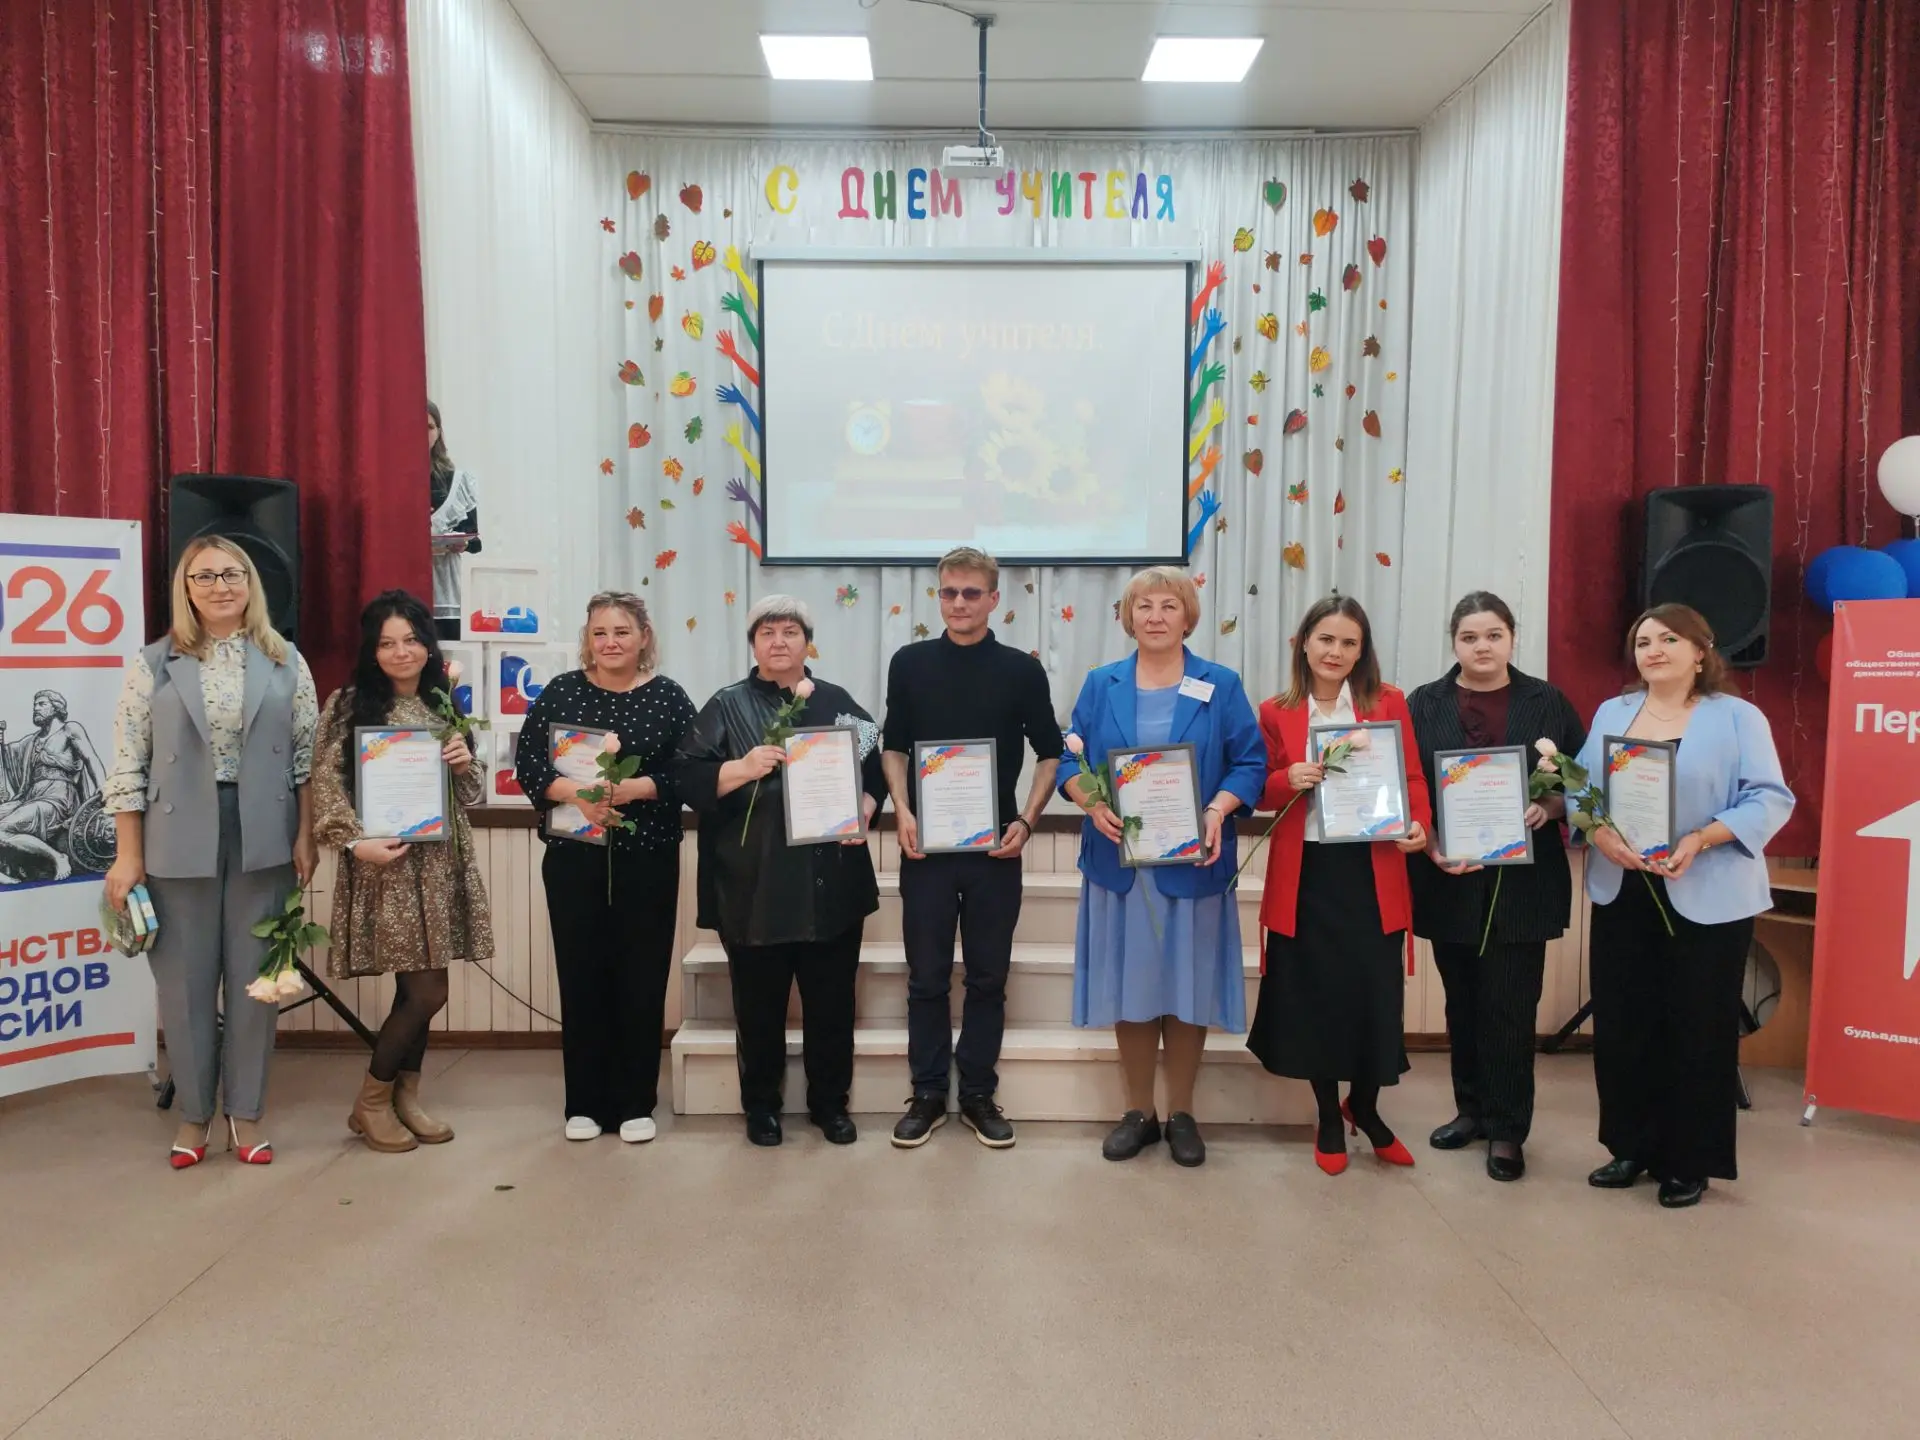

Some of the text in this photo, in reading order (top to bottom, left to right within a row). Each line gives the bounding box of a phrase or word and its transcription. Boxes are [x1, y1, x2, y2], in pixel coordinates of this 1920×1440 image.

[765, 165, 1176, 222] С ДНЕМ УЧИТЕЛЯ
[0, 565, 124, 646] 26
[0, 928, 112, 970] НСТВ
[0, 962, 110, 1006] ОДОВ
[0, 1000, 82, 1041] СИИ
[1844, 1026, 1920, 1044] будьвдви
